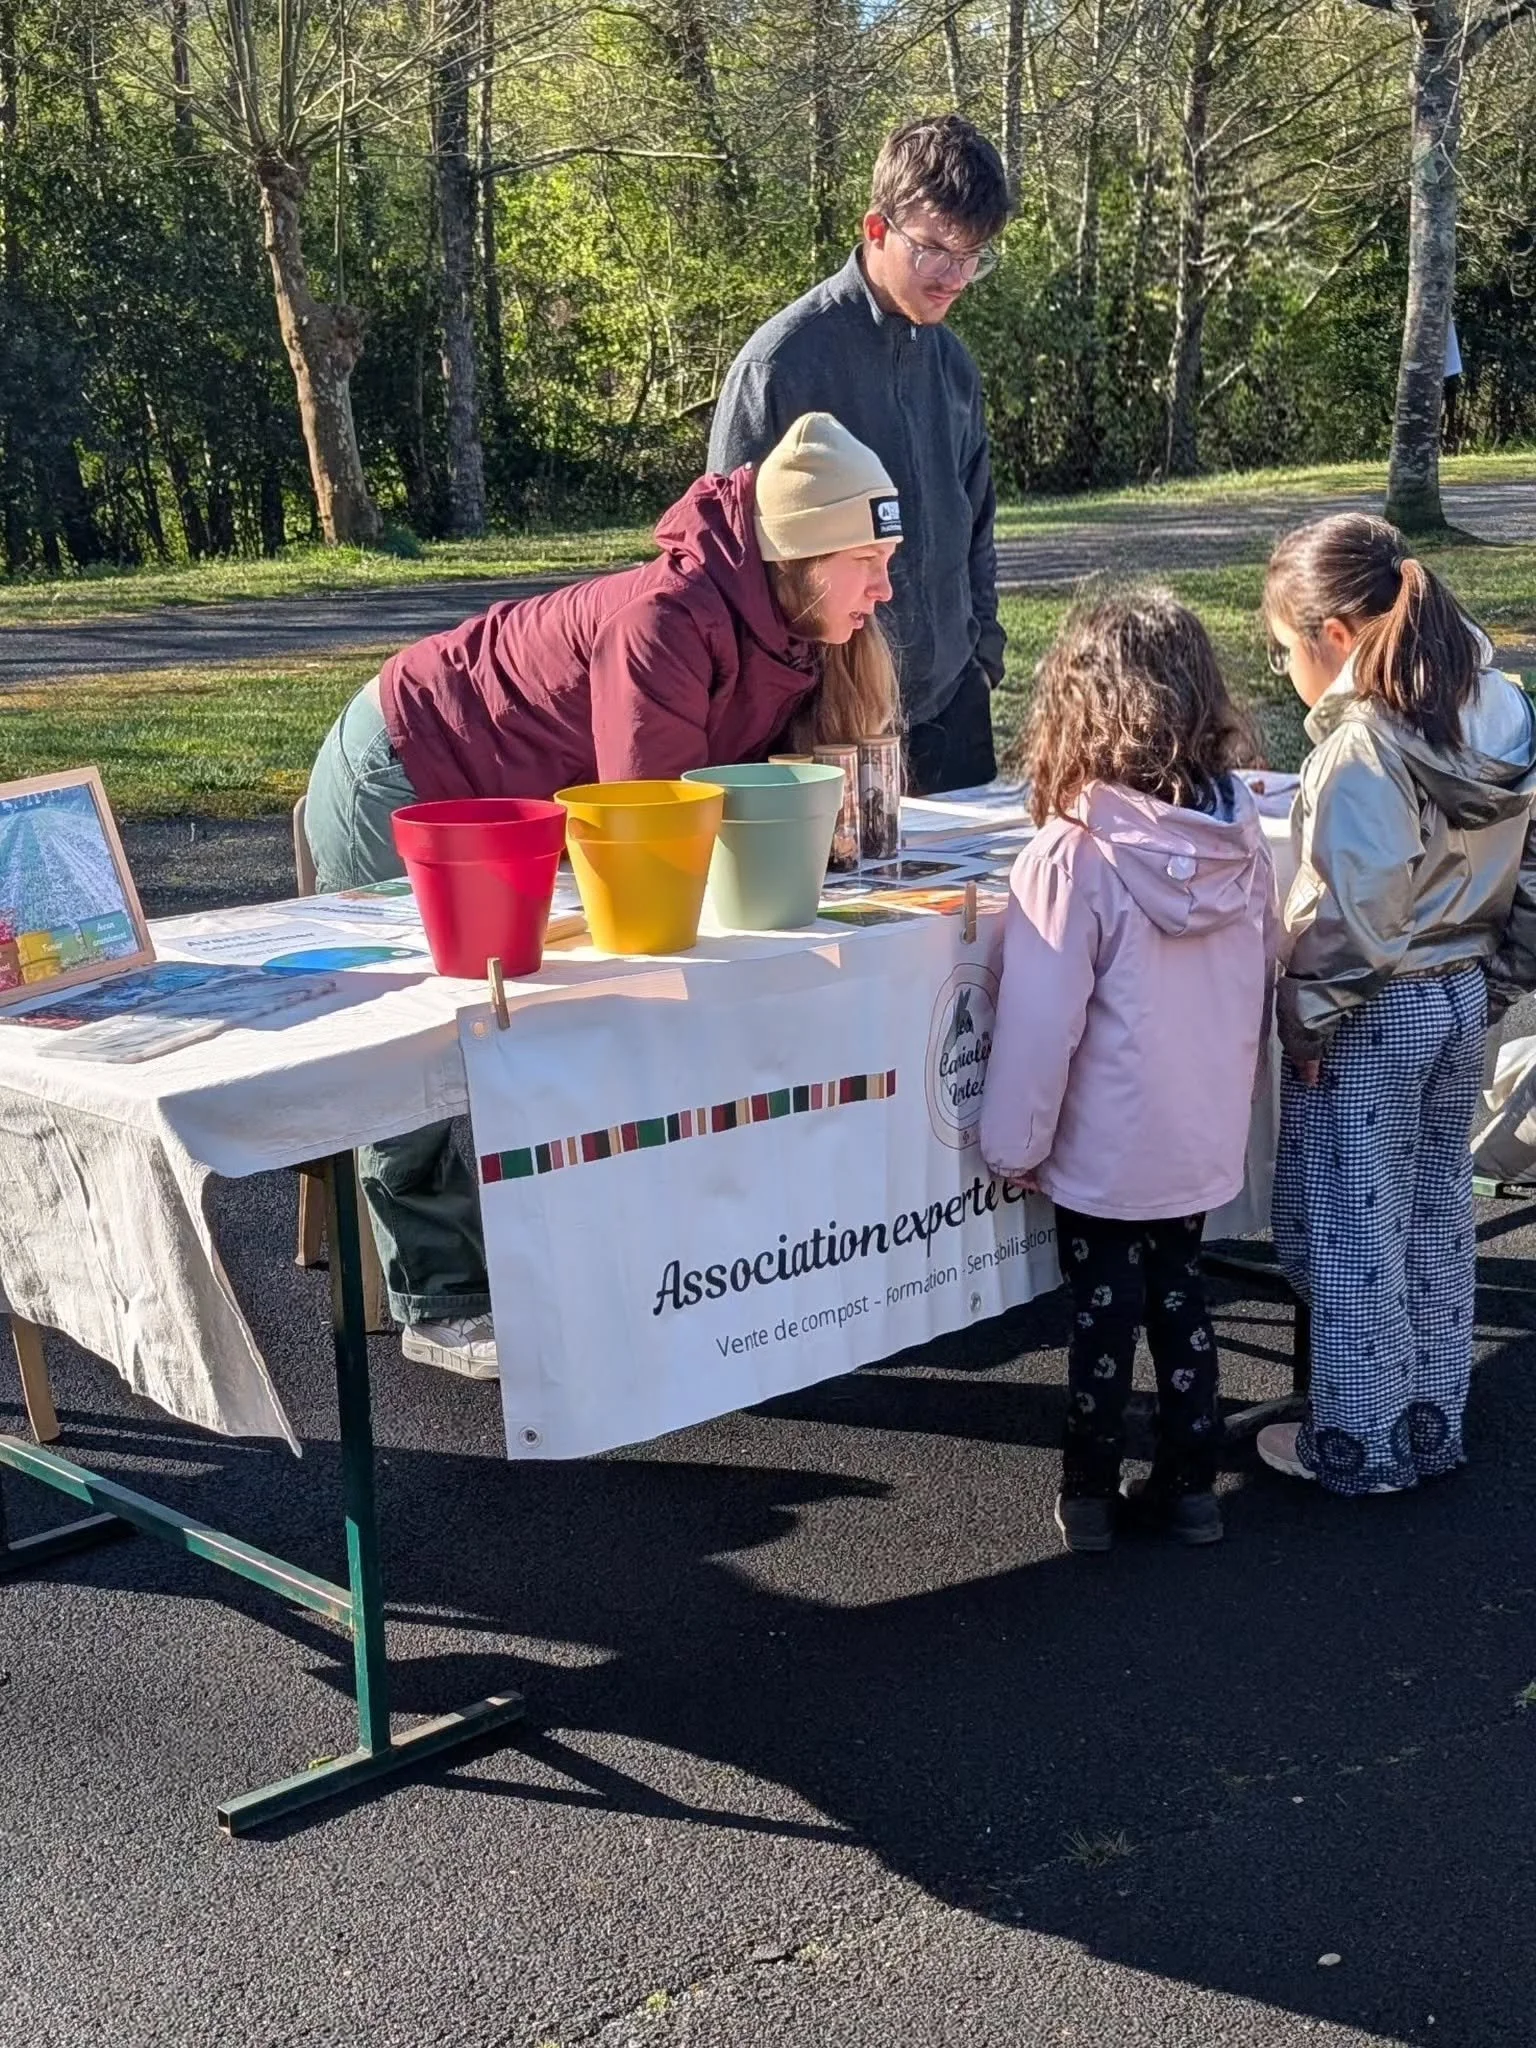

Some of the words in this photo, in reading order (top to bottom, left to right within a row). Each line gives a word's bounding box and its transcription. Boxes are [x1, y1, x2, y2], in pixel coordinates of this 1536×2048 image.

[653, 1220, 890, 1316] Association
[893, 1177, 999, 1258] experte
[1003, 1178, 1036, 1204] e
[716, 1327, 769, 1357] Vente
[774, 1318, 799, 1342] de
[801, 1295, 869, 1333] compost
[886, 1265, 957, 1307] Formation
